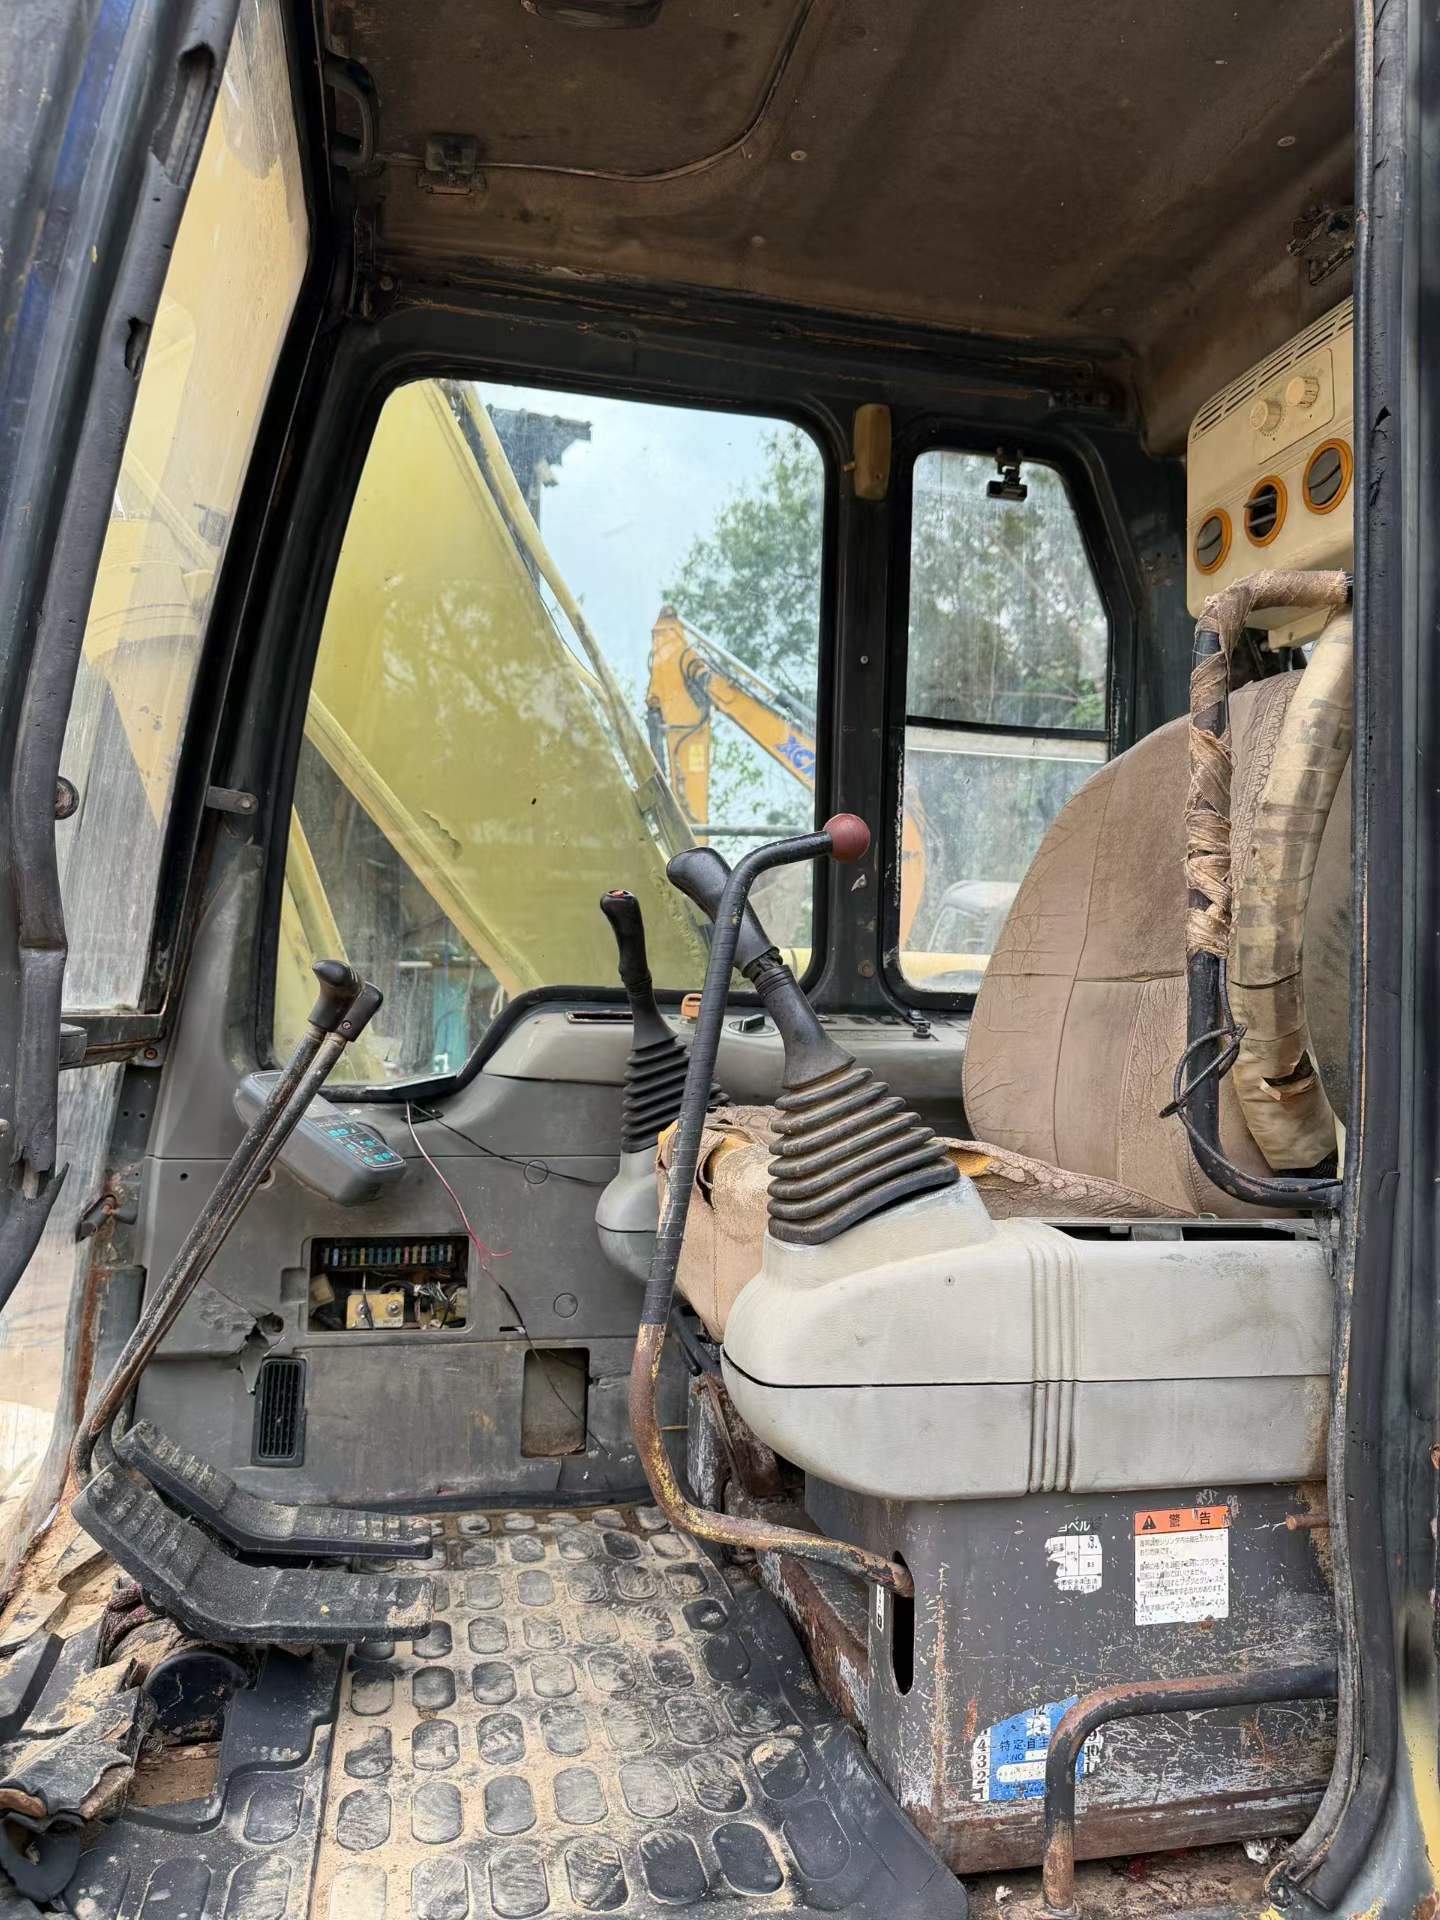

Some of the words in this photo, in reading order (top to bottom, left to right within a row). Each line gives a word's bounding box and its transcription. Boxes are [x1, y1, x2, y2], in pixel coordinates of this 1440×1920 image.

[1168, 1512, 1211, 1528] 警告
[977, 1739, 987, 1752] 4
[976, 1755, 987, 1768] 3
[977, 1771, 987, 1784] 2
